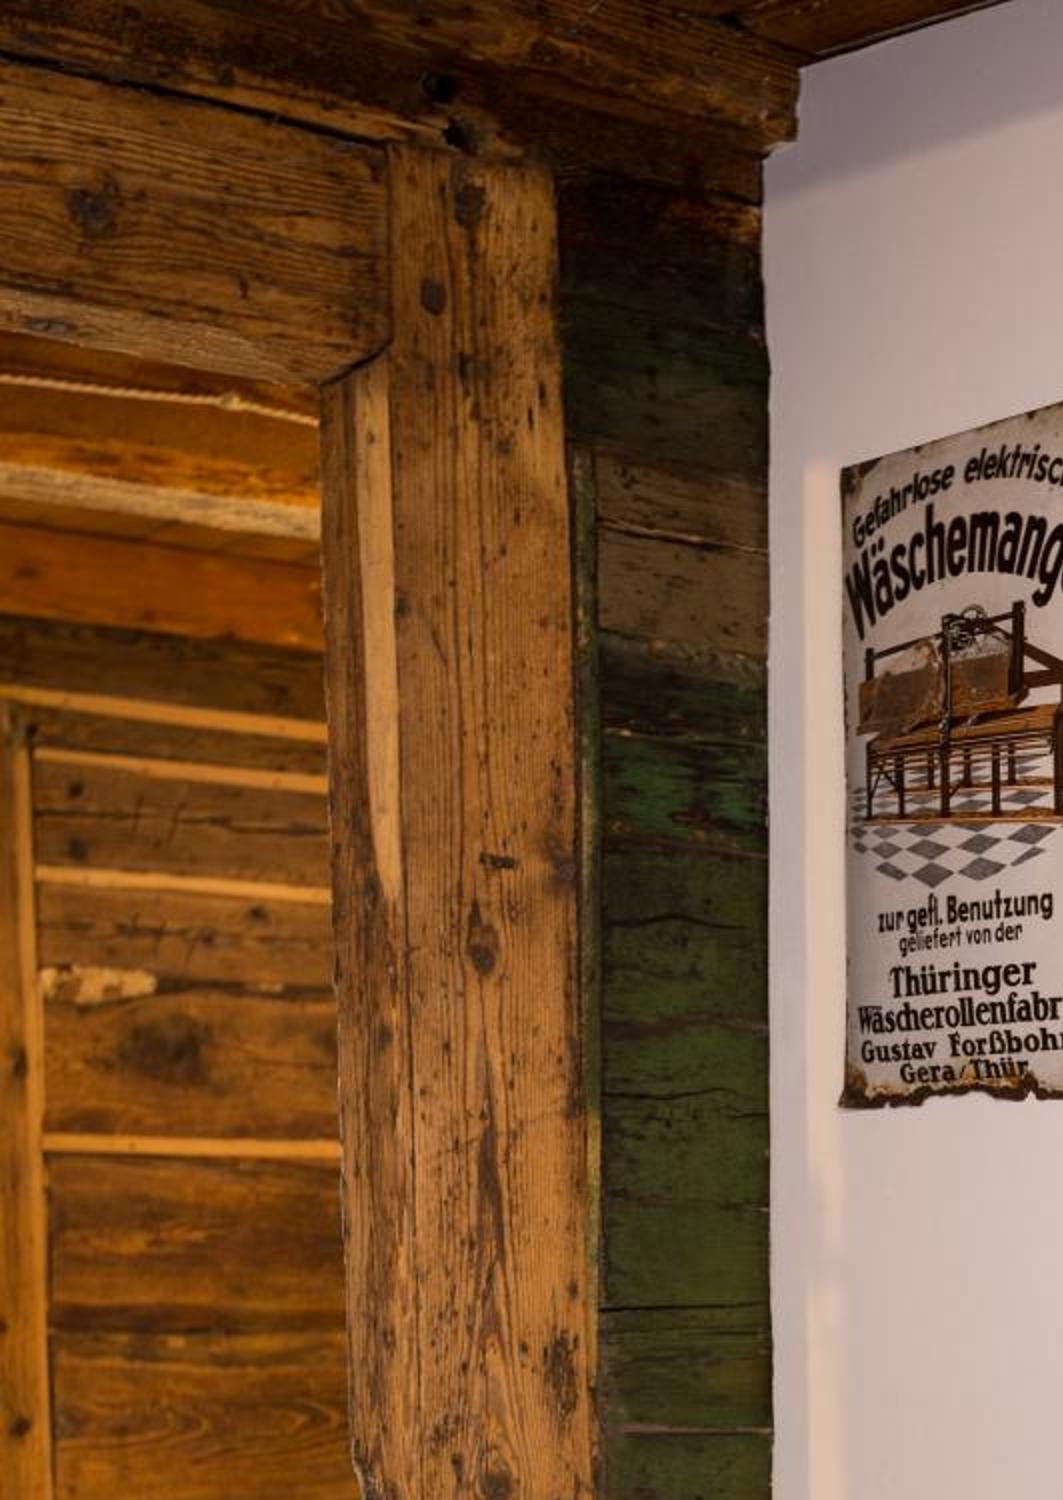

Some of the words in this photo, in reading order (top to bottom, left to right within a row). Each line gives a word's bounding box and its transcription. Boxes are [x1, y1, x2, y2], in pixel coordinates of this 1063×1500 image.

[852, 464, 955, 548] Gefahrlose
[877, 910, 905, 933] zur
[946, 889, 1054, 924] Benutzung
[898, 927, 962, 957] geliefert
[966, 929, 992, 945] von
[995, 922, 1023, 943] der
[889, 961, 1037, 998] Thüringer
[860, 1038, 937, 1064] Gustav
[899, 1062, 956, 1084] Gera
